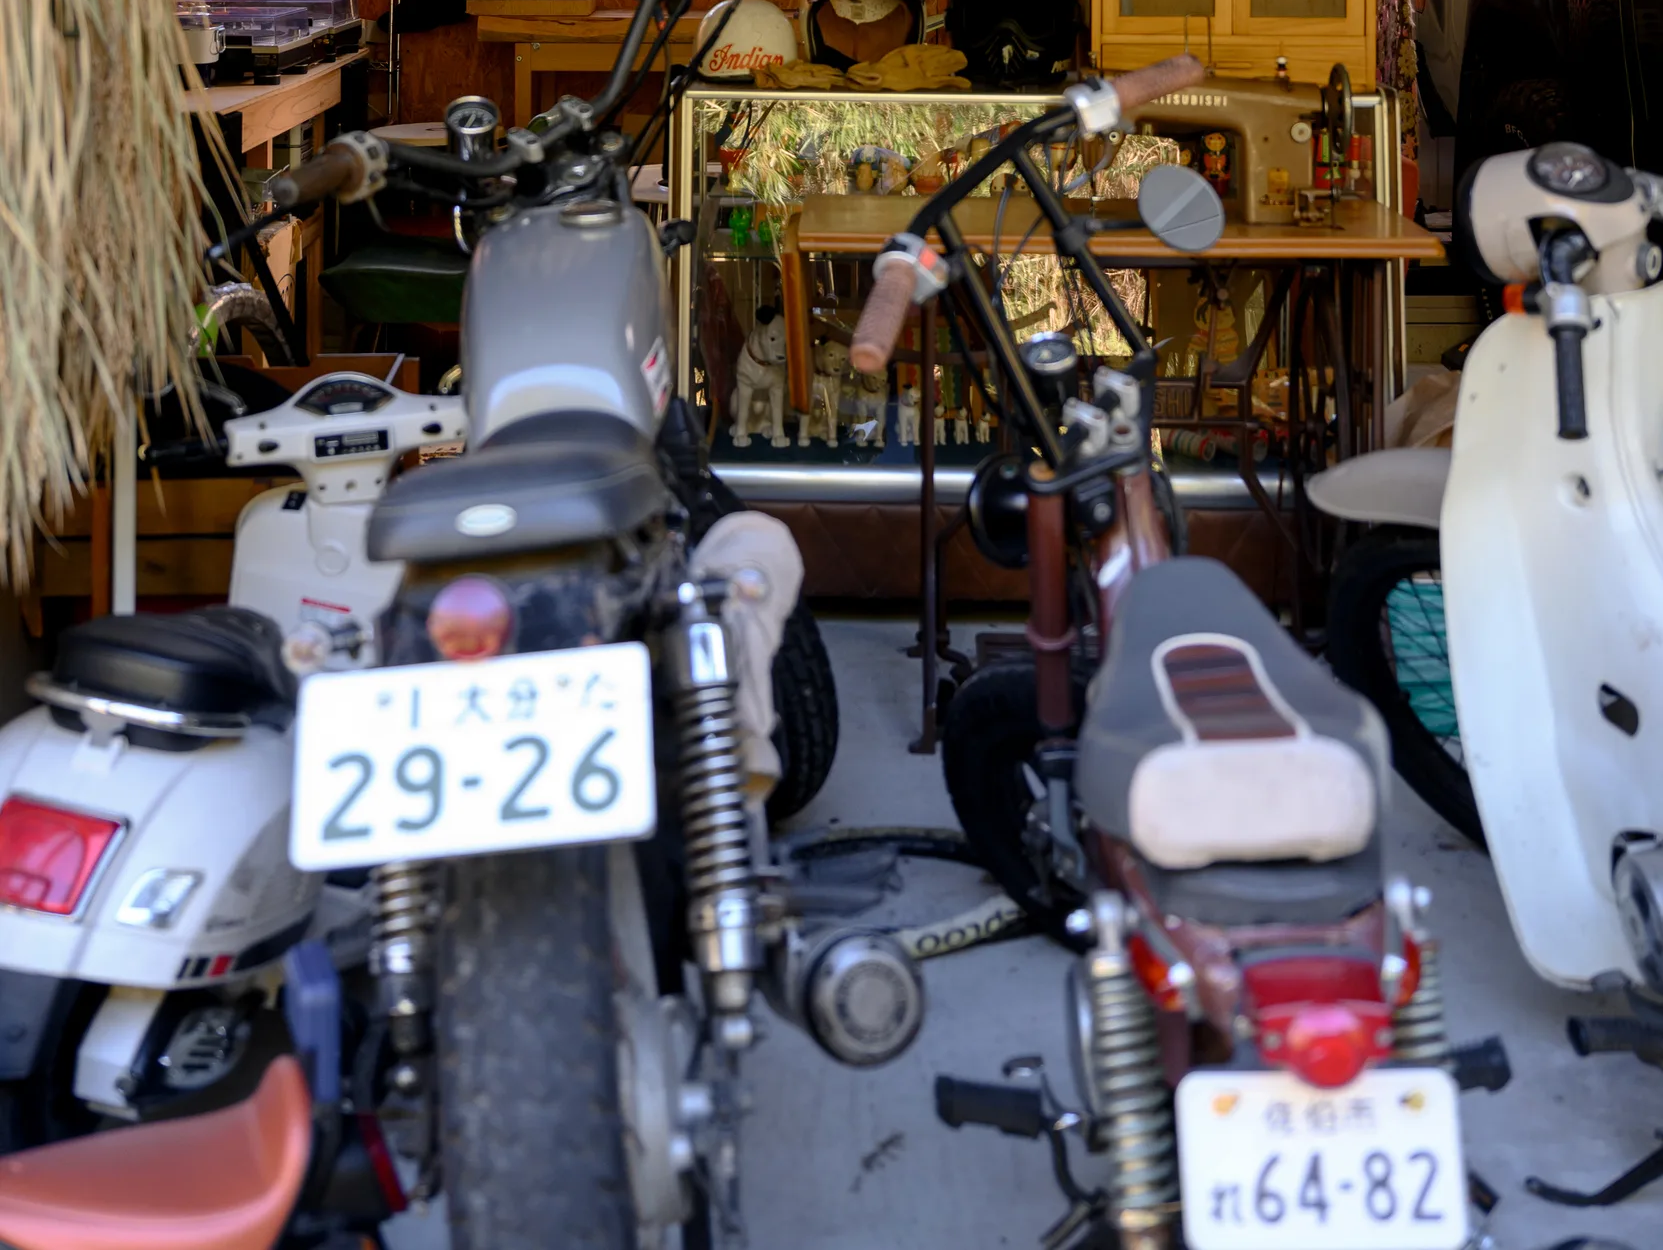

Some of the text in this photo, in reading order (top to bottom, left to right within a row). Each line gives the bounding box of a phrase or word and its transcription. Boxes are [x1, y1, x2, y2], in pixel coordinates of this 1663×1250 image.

[709, 43, 784, 72] Indian
[1150, 93, 1228, 108] ITSUBISHI
[321, 728, 623, 842] 29-26
[1254, 1150, 1444, 1225] 64-82
